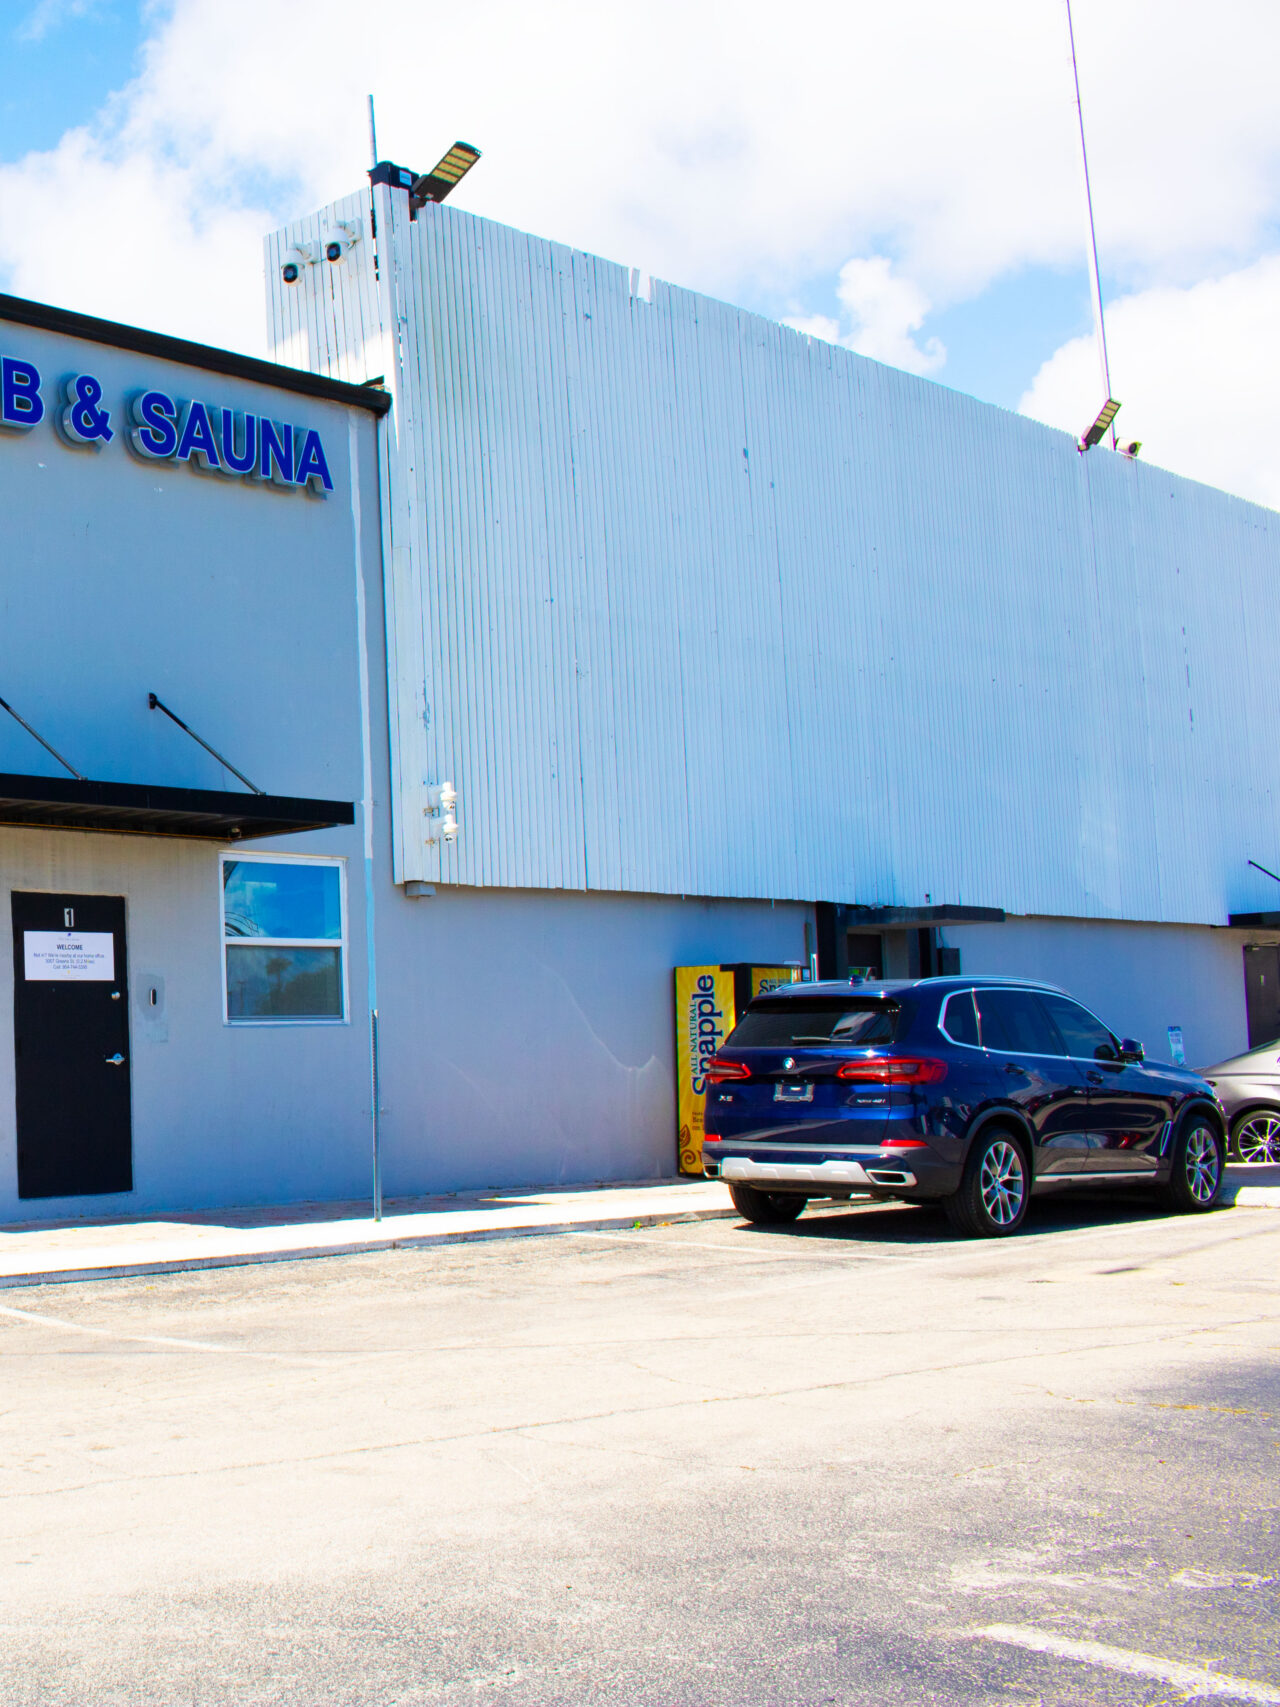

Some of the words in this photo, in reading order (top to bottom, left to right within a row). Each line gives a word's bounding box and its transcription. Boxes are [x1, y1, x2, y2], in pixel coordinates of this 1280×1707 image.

[66, 373, 115, 445] &
[136, 389, 336, 493] SAUNA
[689, 1001, 697, 1053] NATURAL
[690, 1055, 698, 1075] ALL
